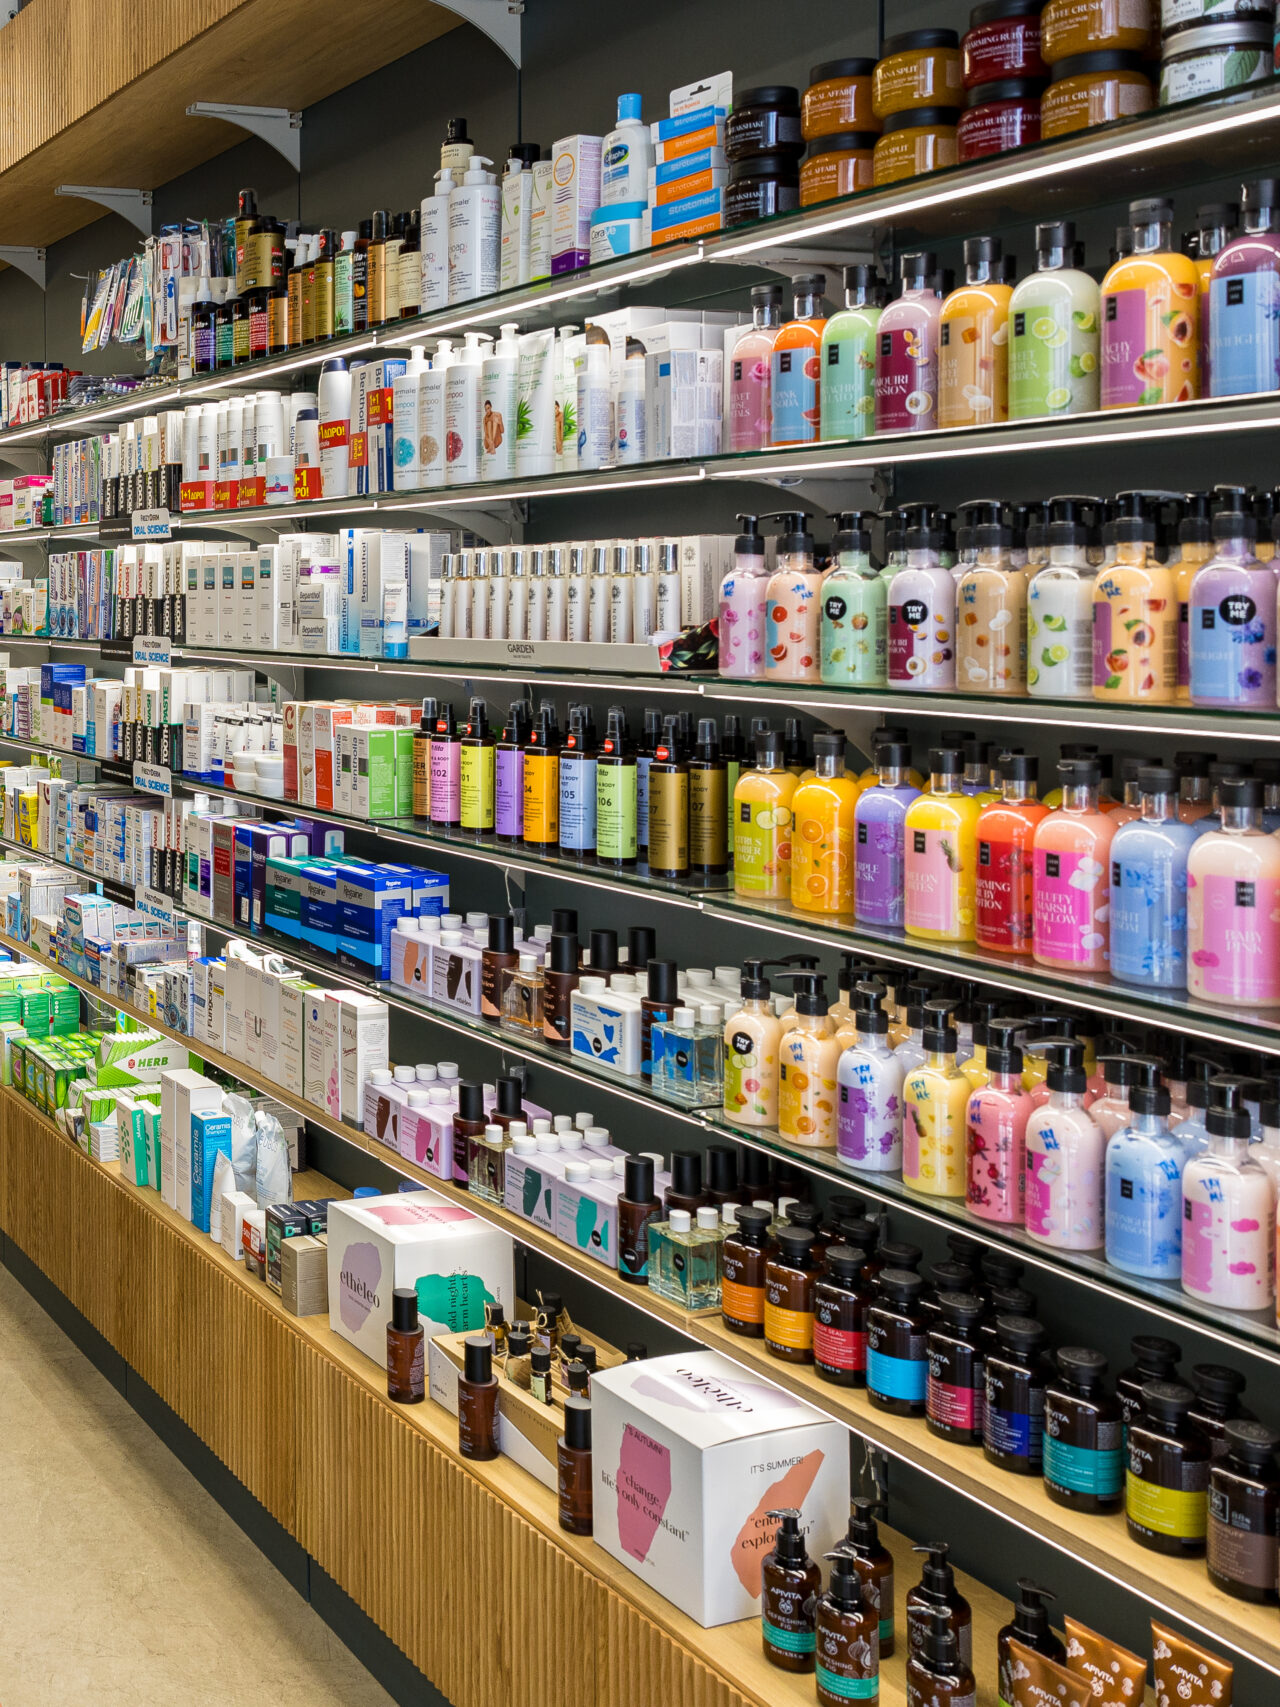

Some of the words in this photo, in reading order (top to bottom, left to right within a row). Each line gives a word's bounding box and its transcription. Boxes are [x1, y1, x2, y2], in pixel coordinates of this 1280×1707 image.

[1071, 2, 1104, 14] CRUSH
[1071, 88, 1104, 101] CRUSH
[888, 145, 908, 154] SPLIT
[667, 176, 710, 194] Stratoderm
[668, 194, 717, 216] Stratomed
[133, 525, 146, 535] ORAL
[147, 524, 169, 534] SCIENCE
[299, 591, 320, 600] Bepanthol
[829, 601, 842, 609] TRY
[830, 607, 840, 615] ME
[906, 605, 923, 613] TRY
[1228, 602, 1250, 611] TRY
[1230, 610, 1246, 619] ME
[302, 625, 324, 633] Bepanthol
[507, 644, 534, 654] GARDEN
[134, 652, 146, 662] ORAL
[147, 652, 169, 663] SCIENCE
[134, 775, 148, 787] ORAL
[148, 780, 170, 793] SCIENCE
[274, 871, 292, 886] Regaine
[308, 882, 326, 897] Regaine
[344, 885, 363, 901] Regaine
[136, 900, 149, 912] ORAL
[150, 906, 171, 922] SCIENCE
[736, 1036, 749, 1045] TRY
[788, 1042, 802, 1052] TRY
[138, 1057, 169, 1067] HERB
[852, 1064, 870, 1074] TRY
[910, 1079, 926, 1091] TRY
[340, 1270, 380, 1308] ethèleo
[767, 1457, 804, 1471] SUMMER!
[622, 1487, 641, 1511] only
[643, 1504, 690, 1542] constant”
[771, 1587, 803, 1600] APIVITA
[780, 1623, 792, 1631] FIG
[818, 1625, 848, 1643] APIVITA
[825, 1663, 837, 1673] FIG
[1082, 1661, 1115, 1686] APIVITA
[1170, 1664, 1204, 1688] APIVITA
[1027, 1684, 1063, 1707] APIVITA
